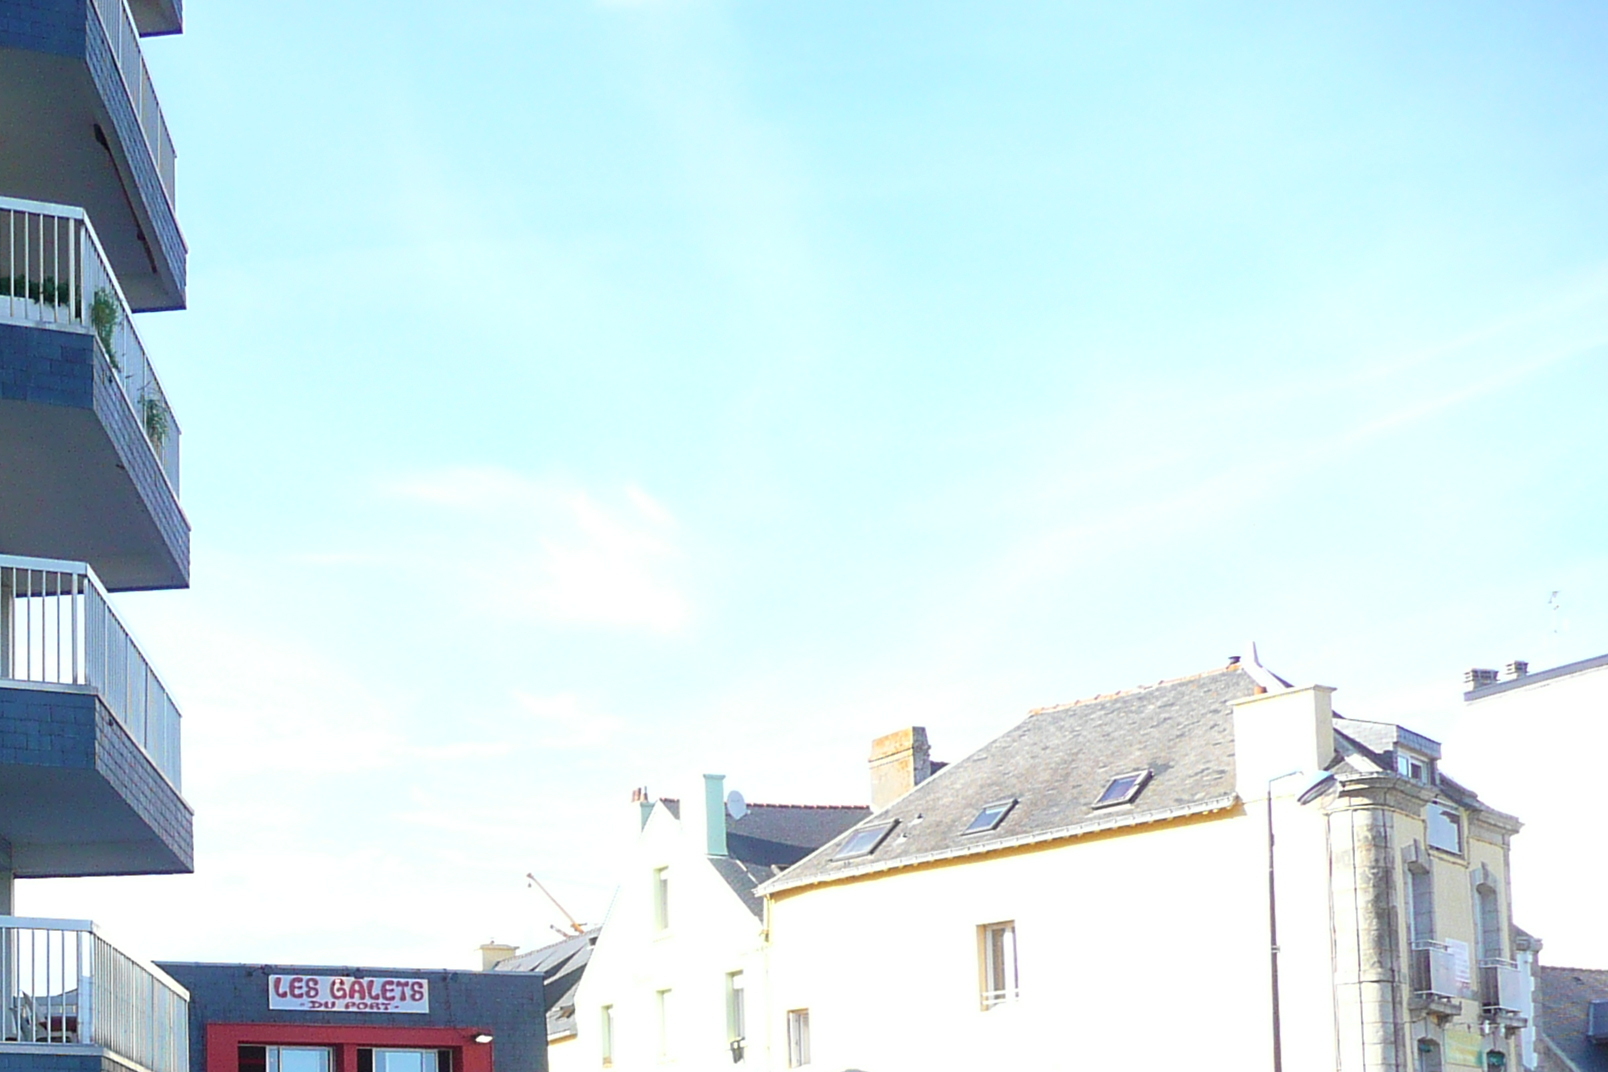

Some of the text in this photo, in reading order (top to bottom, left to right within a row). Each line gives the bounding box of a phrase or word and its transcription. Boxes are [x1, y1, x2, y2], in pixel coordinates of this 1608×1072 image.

[274, 977, 425, 1002] LES GALETS
[309, 1000, 391, 1011] DU PORT
